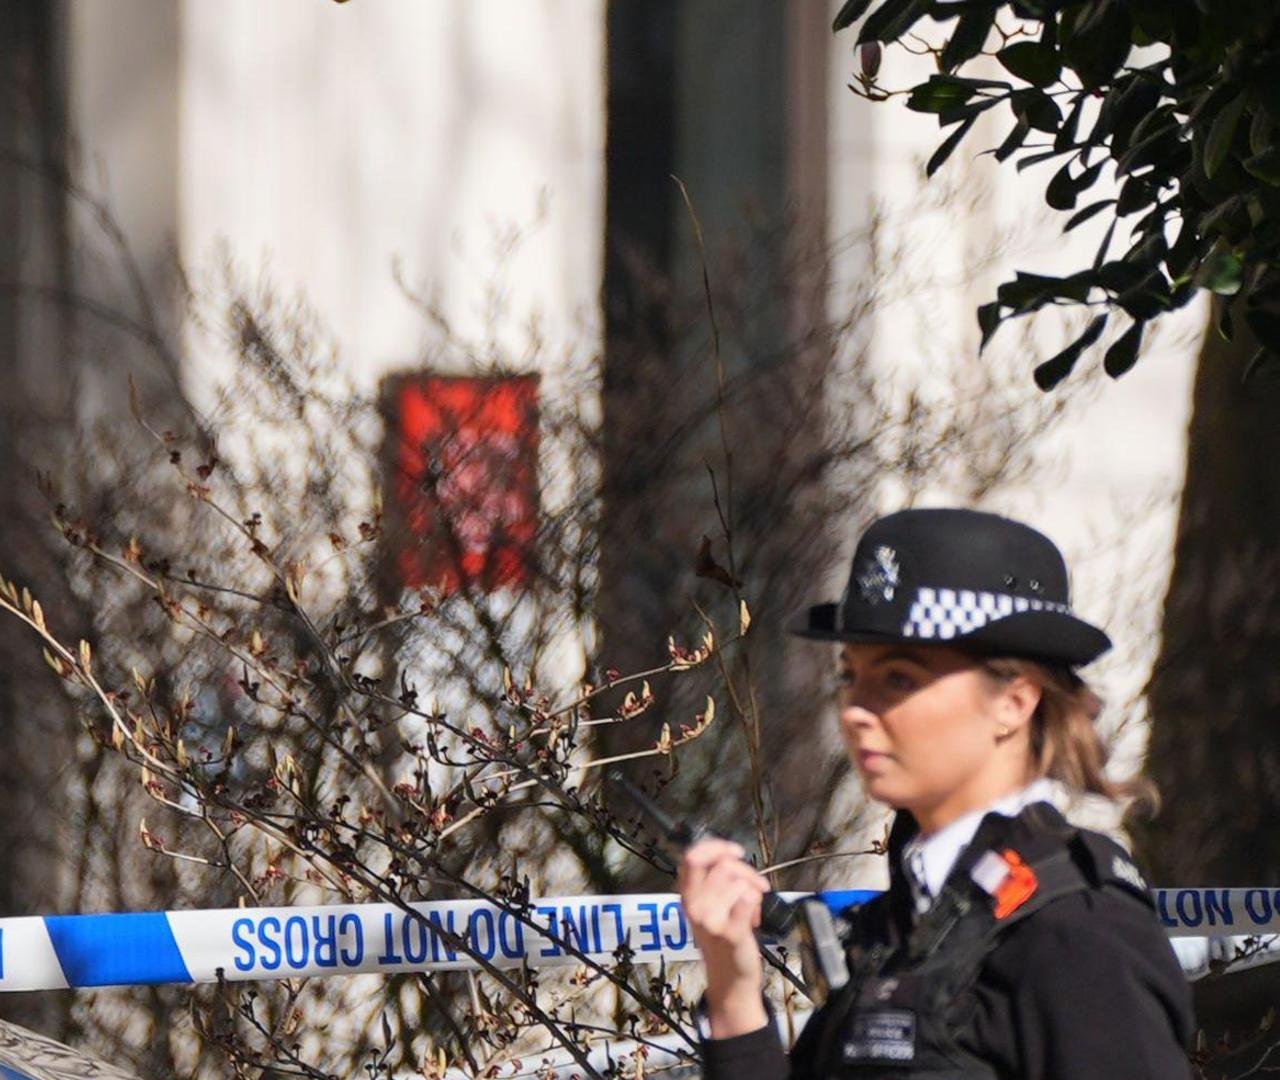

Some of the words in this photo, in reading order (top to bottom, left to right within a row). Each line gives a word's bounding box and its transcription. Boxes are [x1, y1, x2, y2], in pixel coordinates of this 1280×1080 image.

[469, 908, 525, 960] DO
[537, 904, 624, 957] LINE
[1157, 889, 1234, 928] NOT
[232, 913, 364, 972] CROSS
[378, 911, 458, 965] NOT
